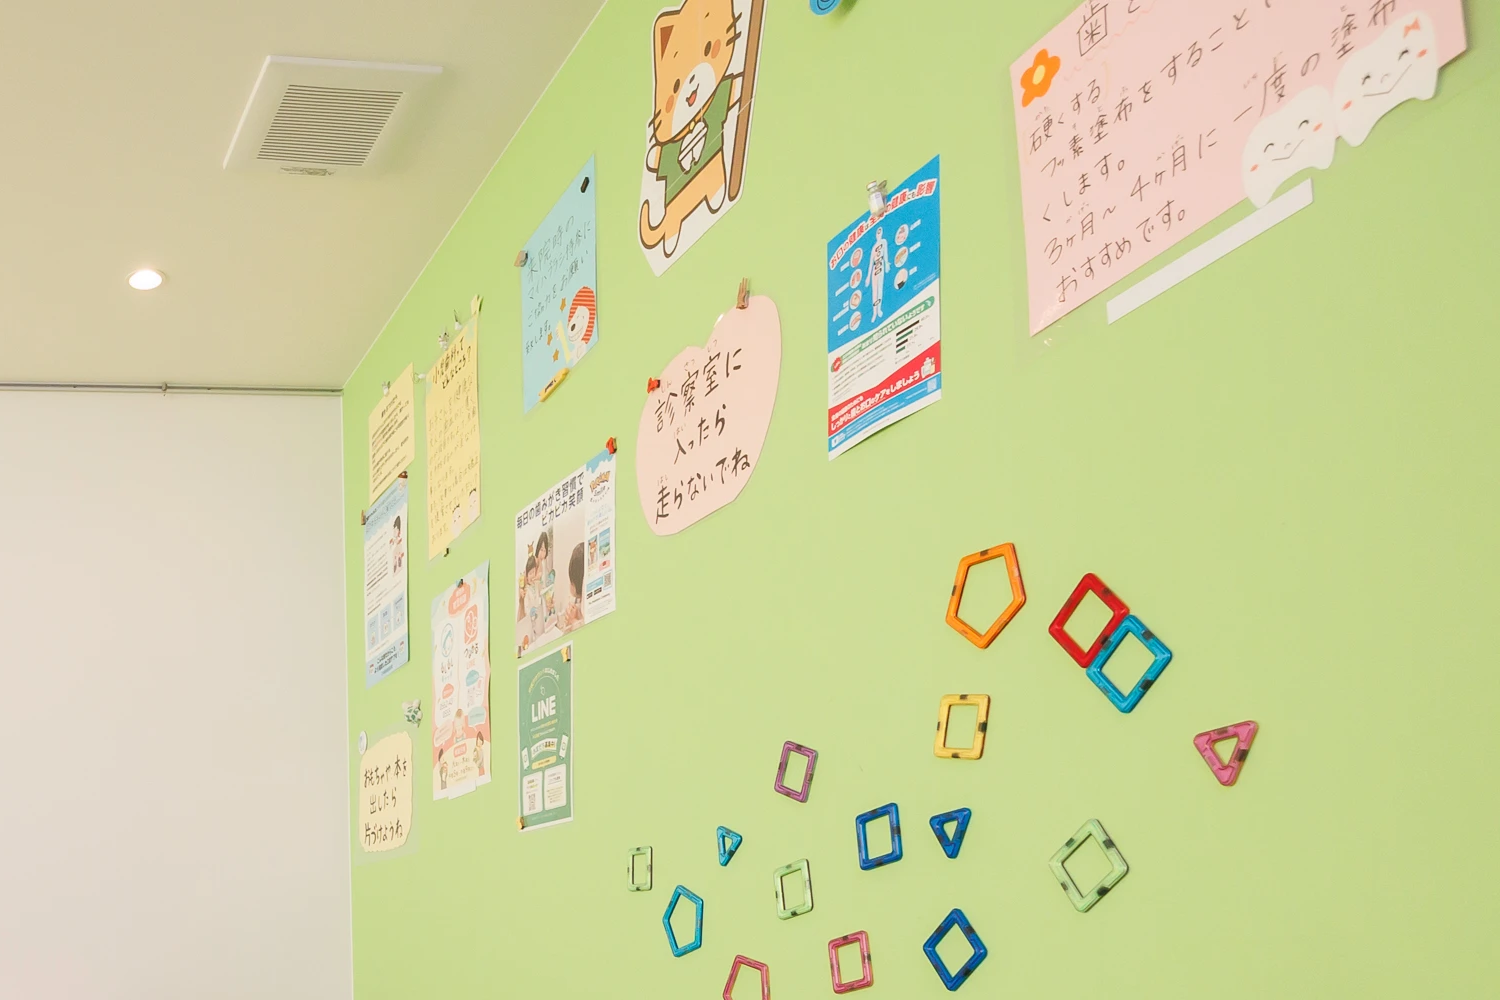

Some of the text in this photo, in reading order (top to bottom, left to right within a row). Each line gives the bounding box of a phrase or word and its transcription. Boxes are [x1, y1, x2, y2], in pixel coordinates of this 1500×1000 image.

[1056, 200, 1186, 303] おすすめです。
[654, 347, 743, 433] 診察室に
[673, 402, 728, 465] 入ったら
[516, 472, 584, 529] 毎日の歯みがき習慣で
[542, 487, 584, 527] ピカピカ笑顔
[655, 446, 752, 525] 走らないでね
[531, 694, 557, 723] LINE
[369, 786, 397, 815] 出したら
[364, 817, 404, 847] 片づけようね
